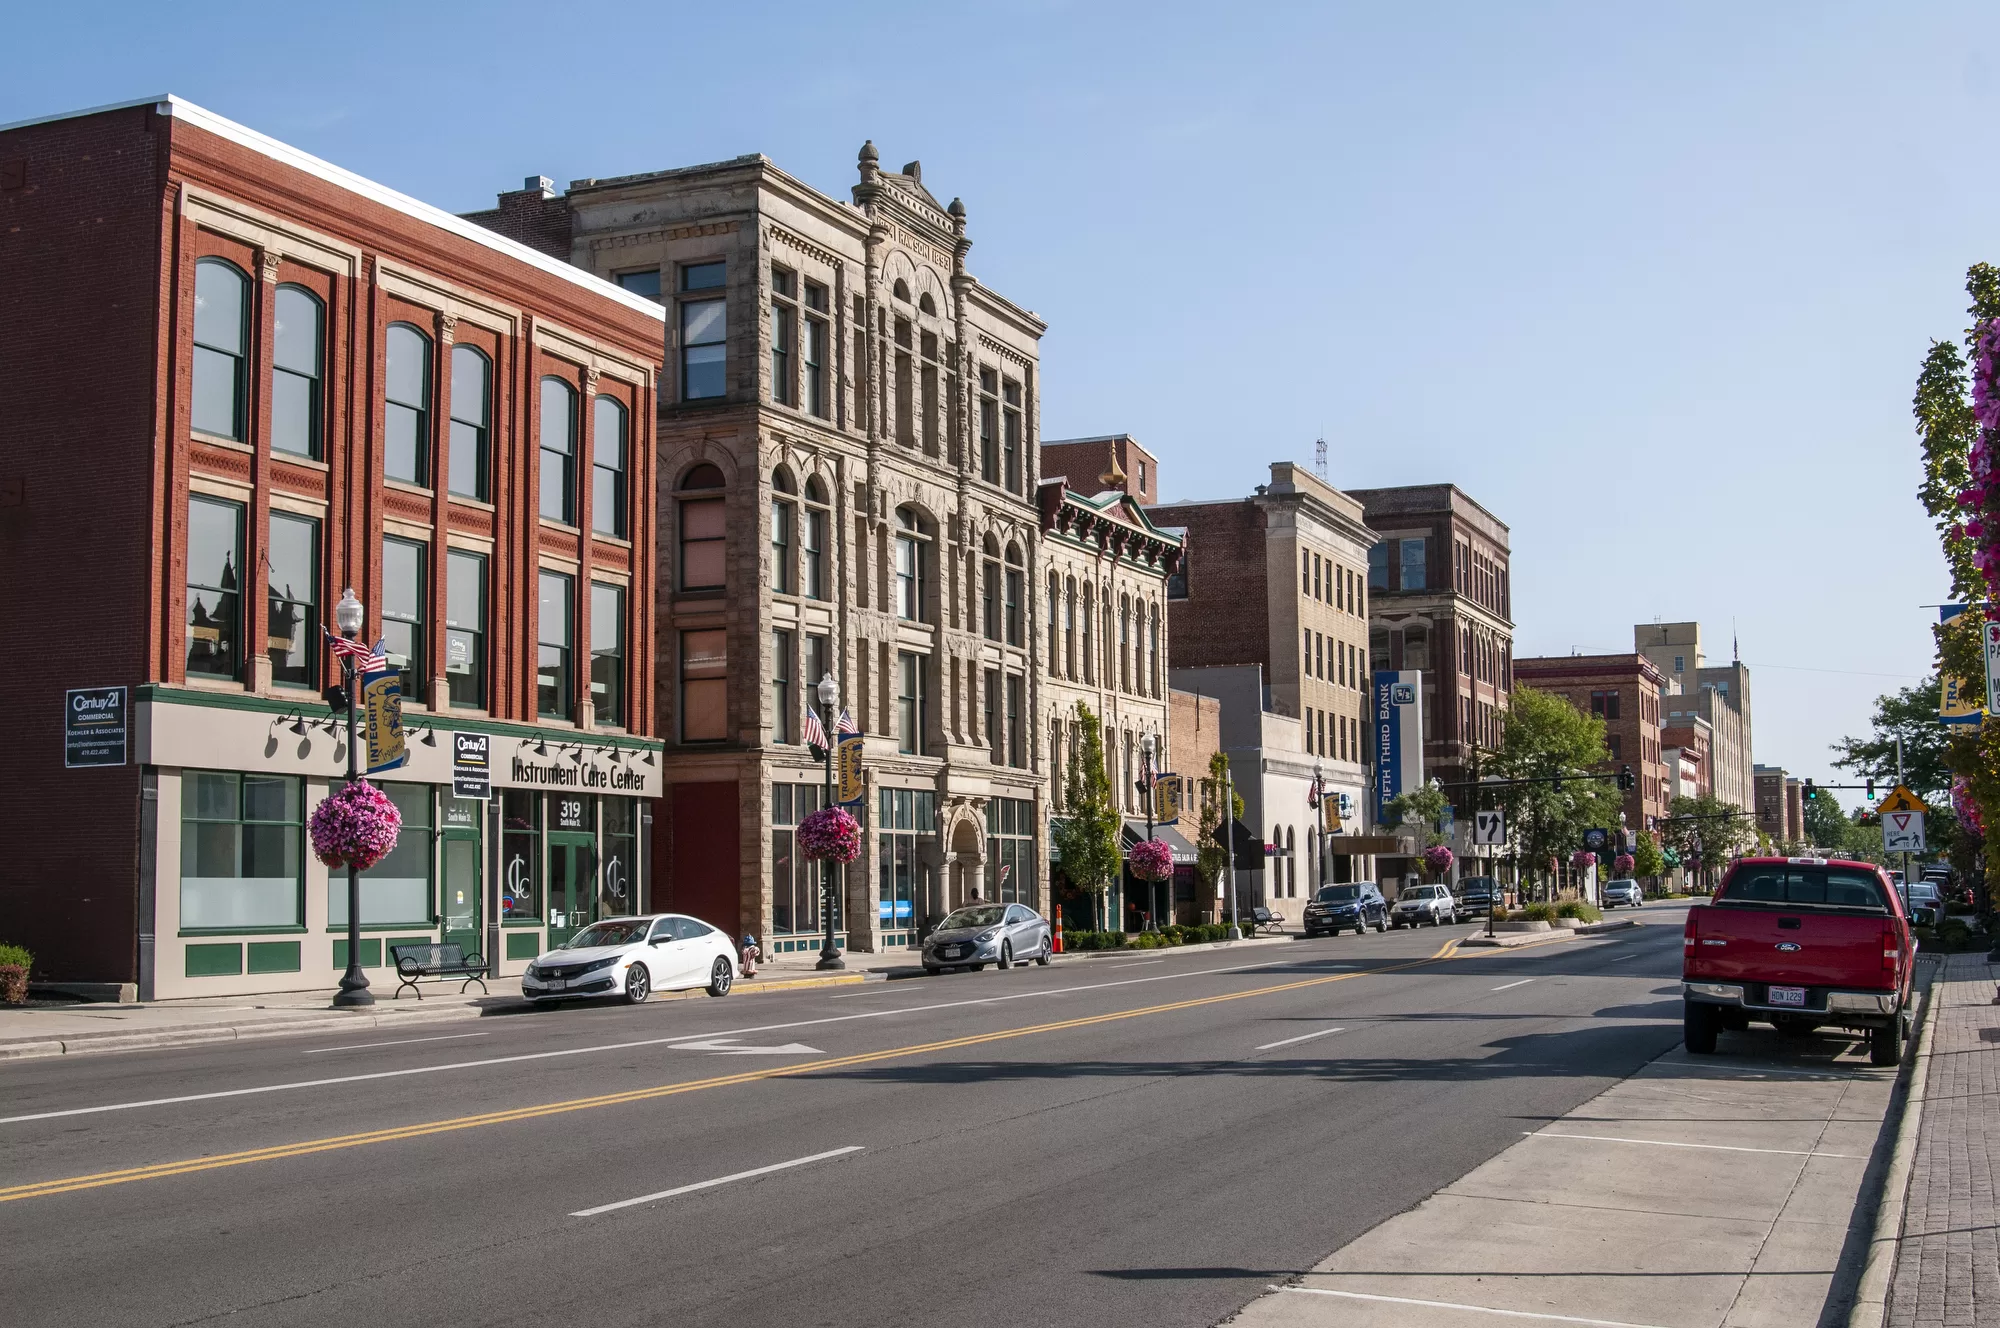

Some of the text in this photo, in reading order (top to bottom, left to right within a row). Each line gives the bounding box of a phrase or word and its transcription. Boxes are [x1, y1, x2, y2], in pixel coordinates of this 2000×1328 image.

[899, 230, 928, 259] RAWSON
[932, 250, 948, 271] 1893
[368, 692, 379, 762] INTEGRITY
[1380, 683, 1391, 805] FIFTH THIRD BANK
[512, 757, 645, 790] Instrument Care Center
[561, 801, 580, 818] 319
[1786, 992, 1802, 1001] 1229
